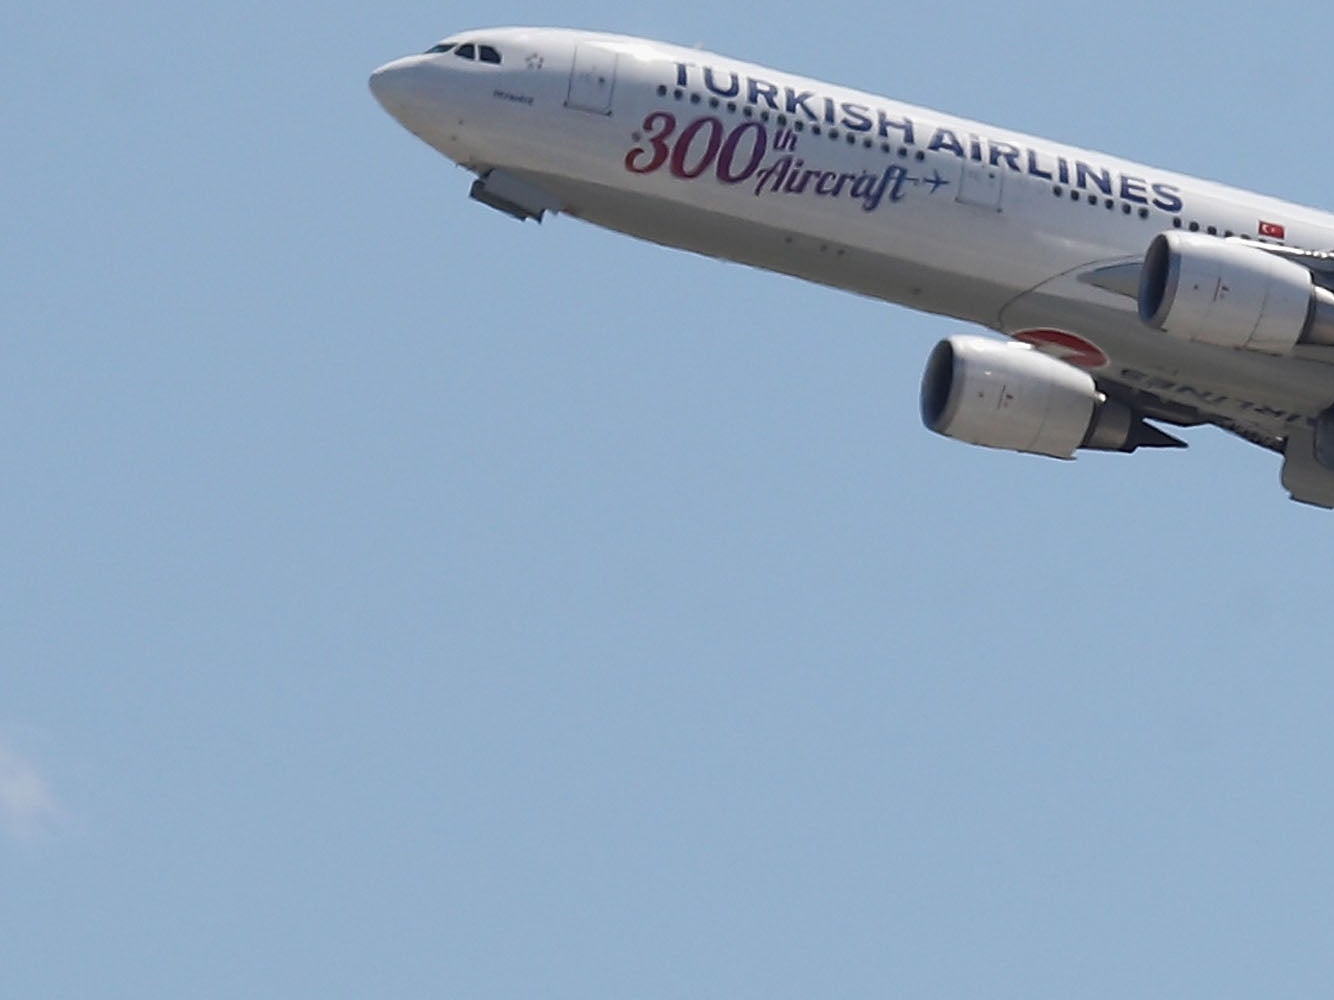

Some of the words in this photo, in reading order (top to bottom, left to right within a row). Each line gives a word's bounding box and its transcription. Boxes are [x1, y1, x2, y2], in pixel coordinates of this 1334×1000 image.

[673, 62, 915, 145] TURKISH
[927, 127, 1183, 213] AIRLINES
[754, 154, 909, 212] Aircraft
